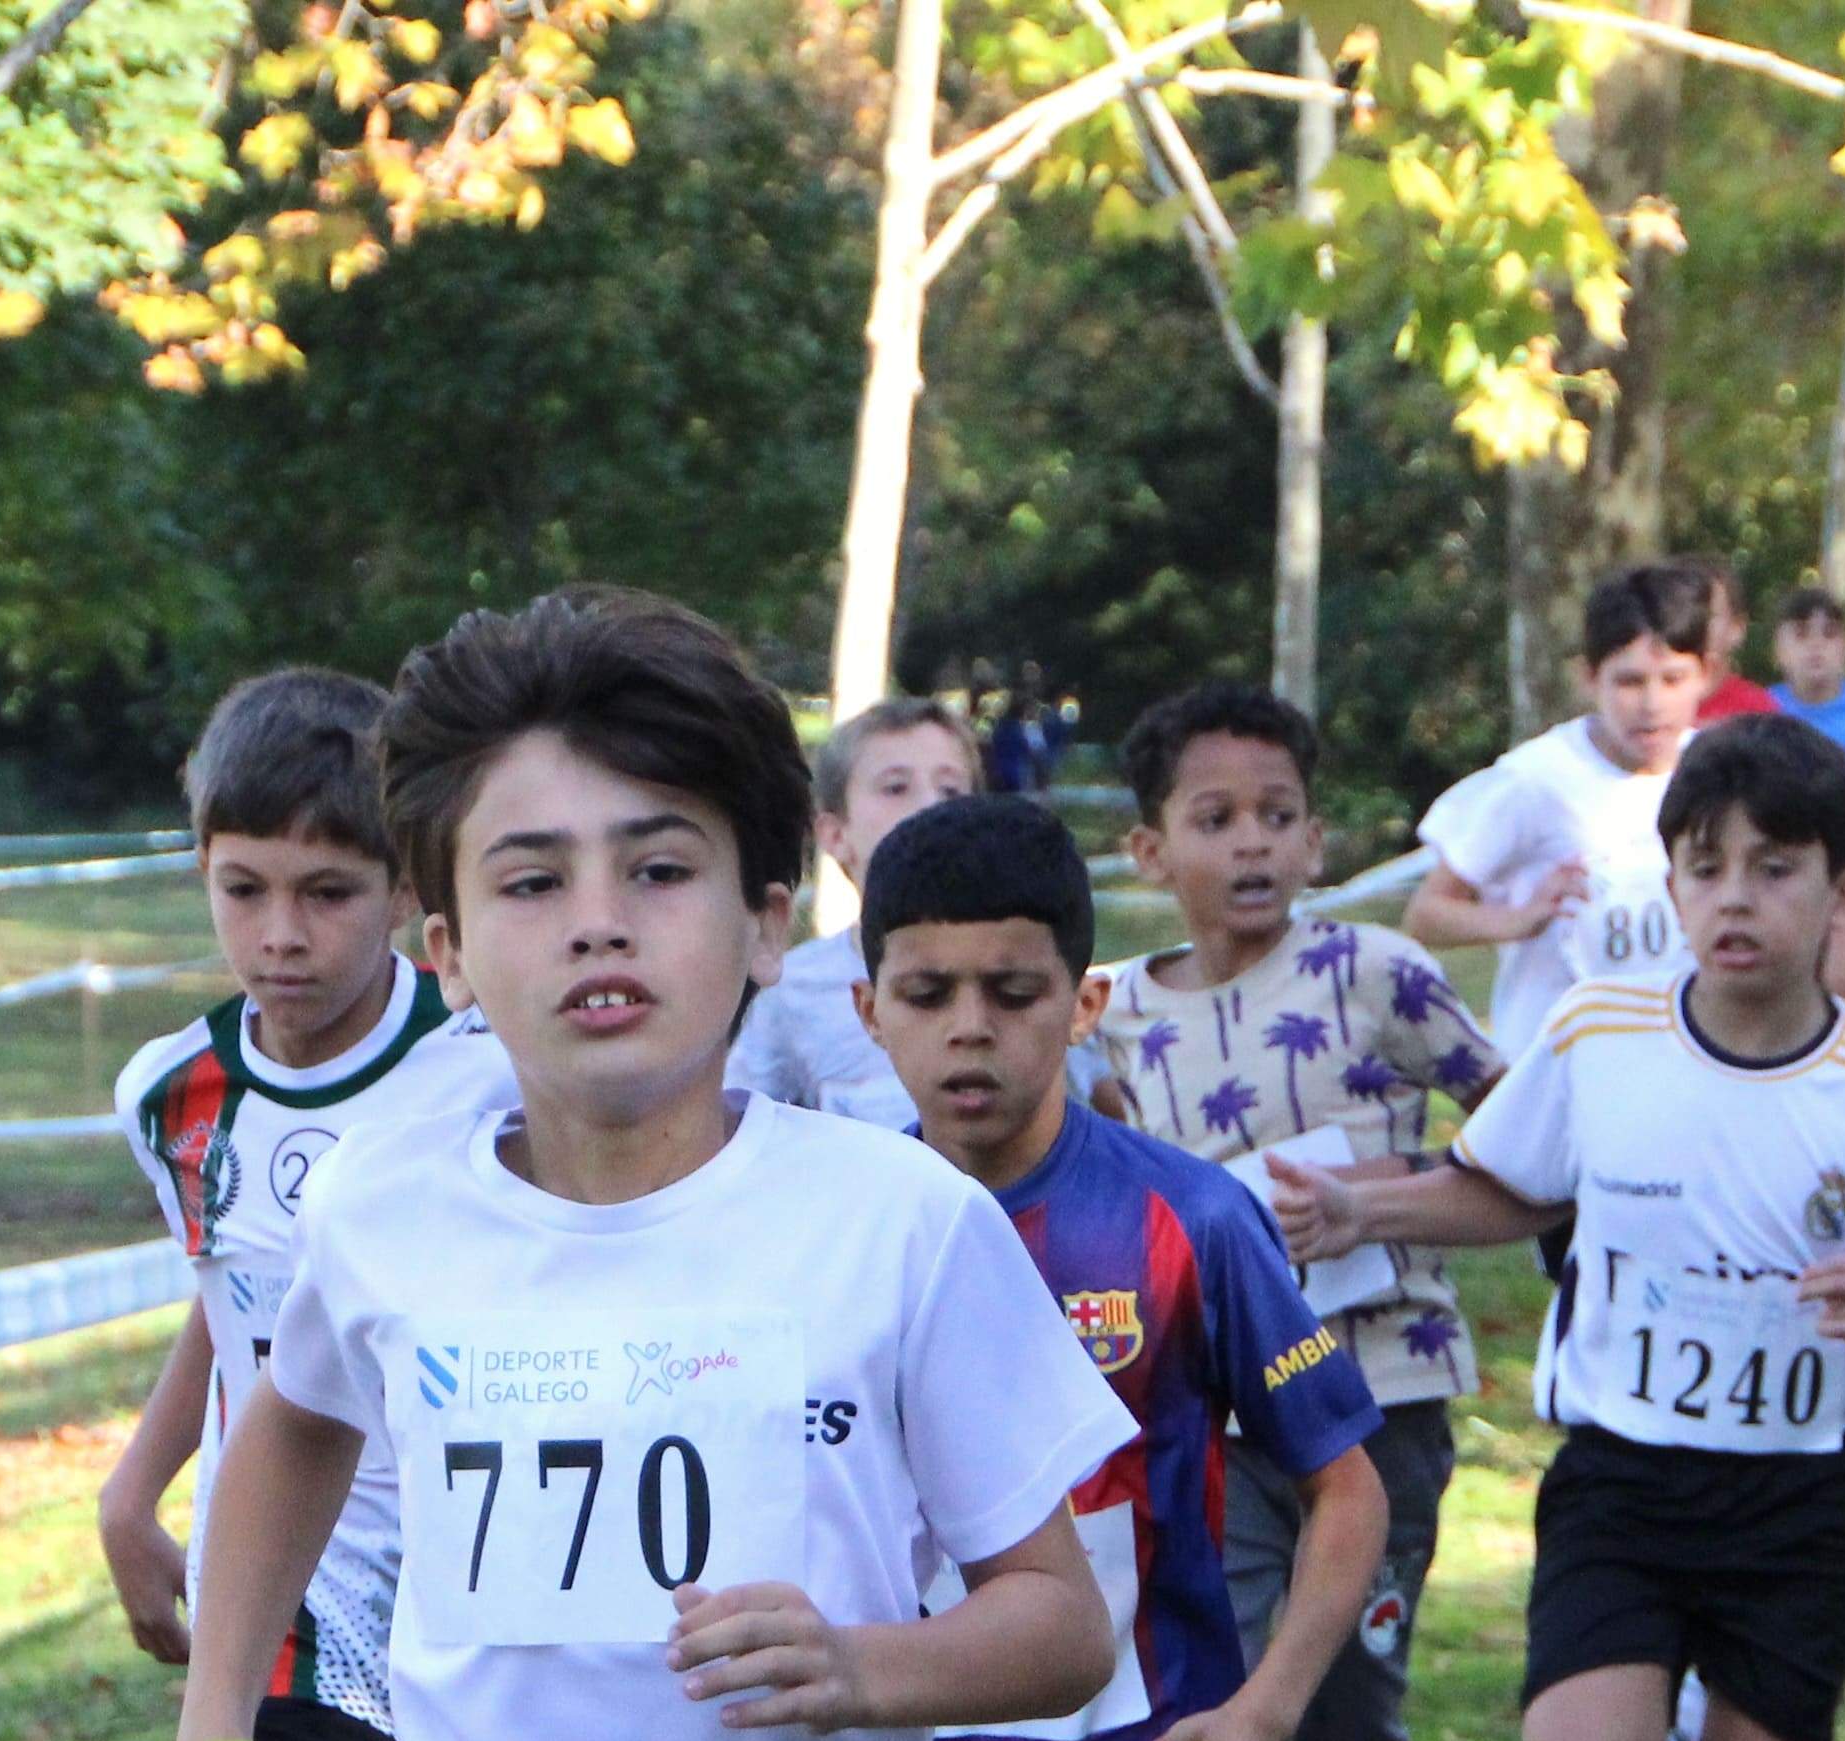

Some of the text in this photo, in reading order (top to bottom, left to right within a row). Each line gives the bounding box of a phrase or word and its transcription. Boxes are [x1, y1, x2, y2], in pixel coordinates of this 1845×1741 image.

[484, 1348, 600, 1372] DEPORTE
[1629, 1325, 1824, 1426] 1240
[483, 1380, 589, 1403] GALEGO
[444, 1434, 712, 1593] 770
